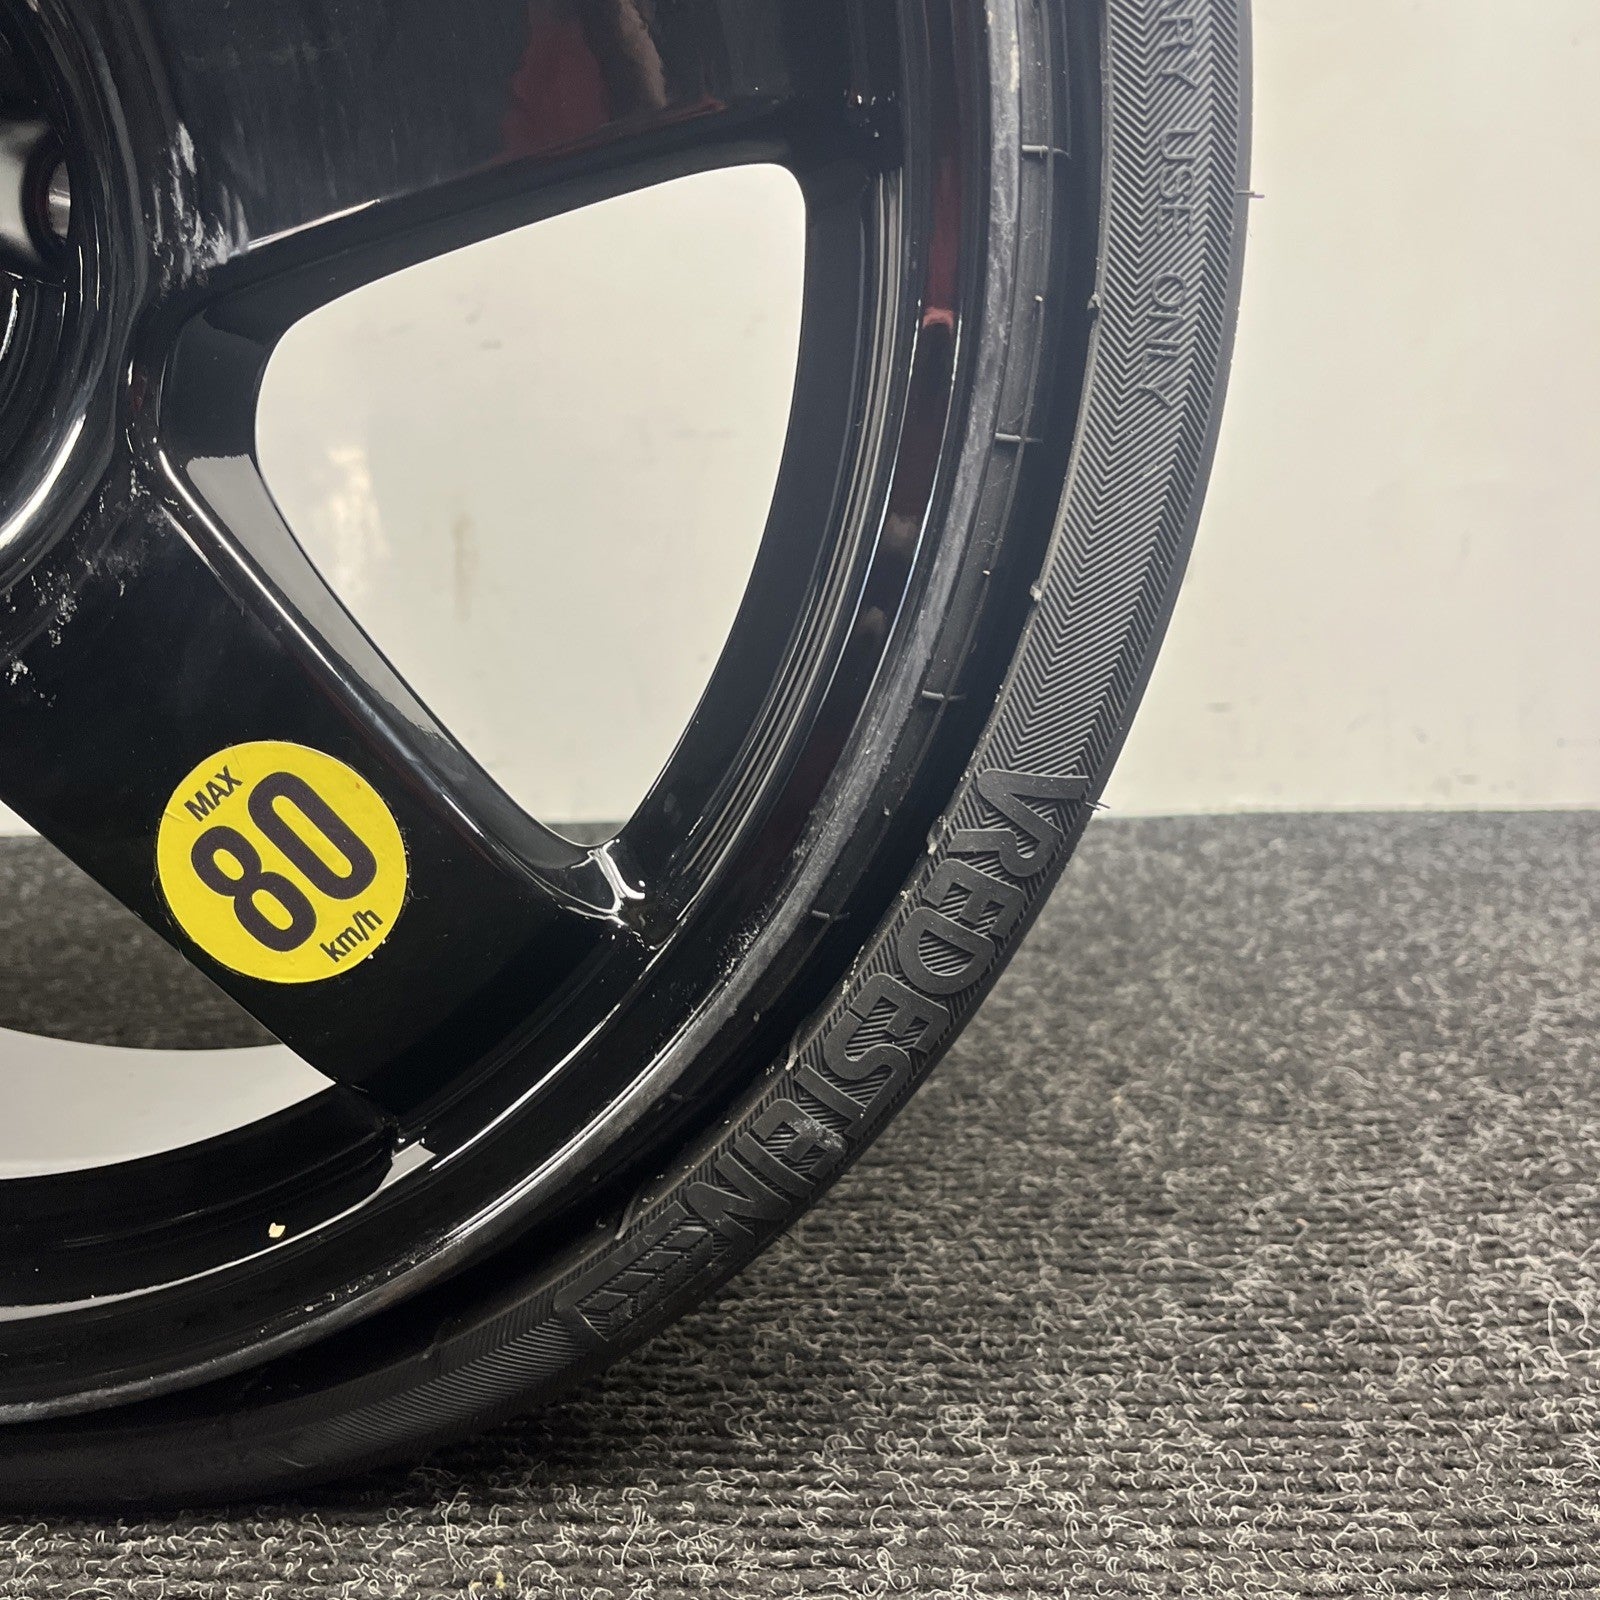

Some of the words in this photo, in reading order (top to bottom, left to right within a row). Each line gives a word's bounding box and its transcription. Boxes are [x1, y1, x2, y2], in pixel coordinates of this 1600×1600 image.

[1159, 0, 1199, 88] RY
[1156, 127, 1200, 235] USE
[1139, 273, 1187, 408] ONLY
[184, 765, 243, 822] MAX
[191, 771, 378, 953] 80
[319, 908, 384, 963] km/h
[686, 768, 1090, 1238] VREDESTEIN
